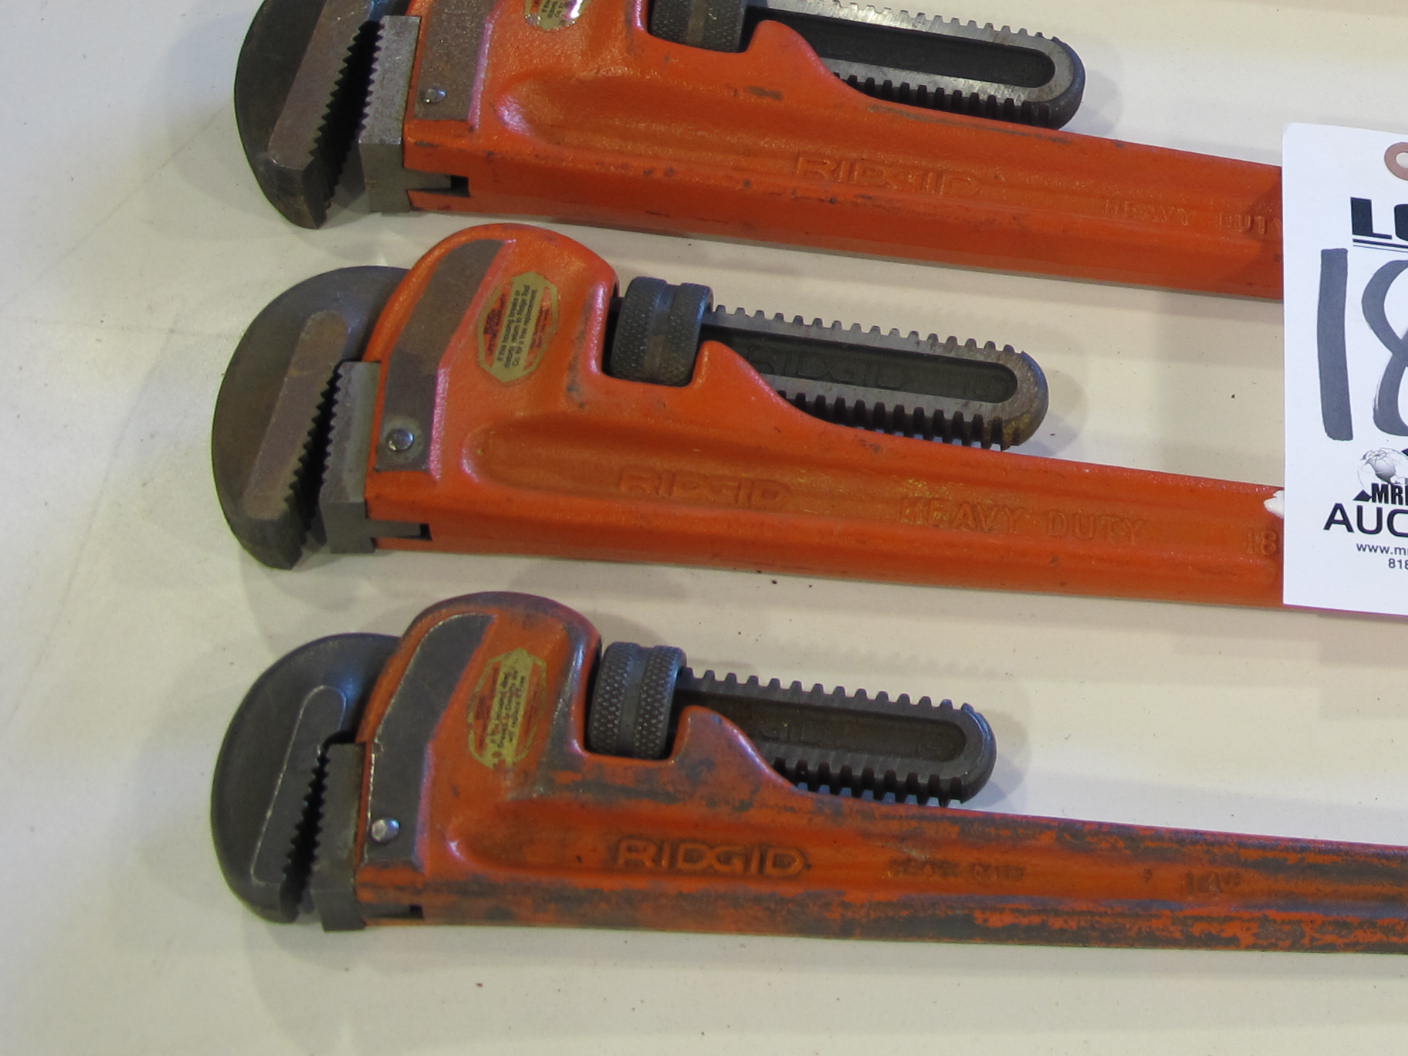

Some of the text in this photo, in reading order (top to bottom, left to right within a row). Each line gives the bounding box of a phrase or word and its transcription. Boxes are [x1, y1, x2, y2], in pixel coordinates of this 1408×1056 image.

[900, 497, 1147, 544] HEAVY DUTY
[610, 834, 812, 879] RIDGID
